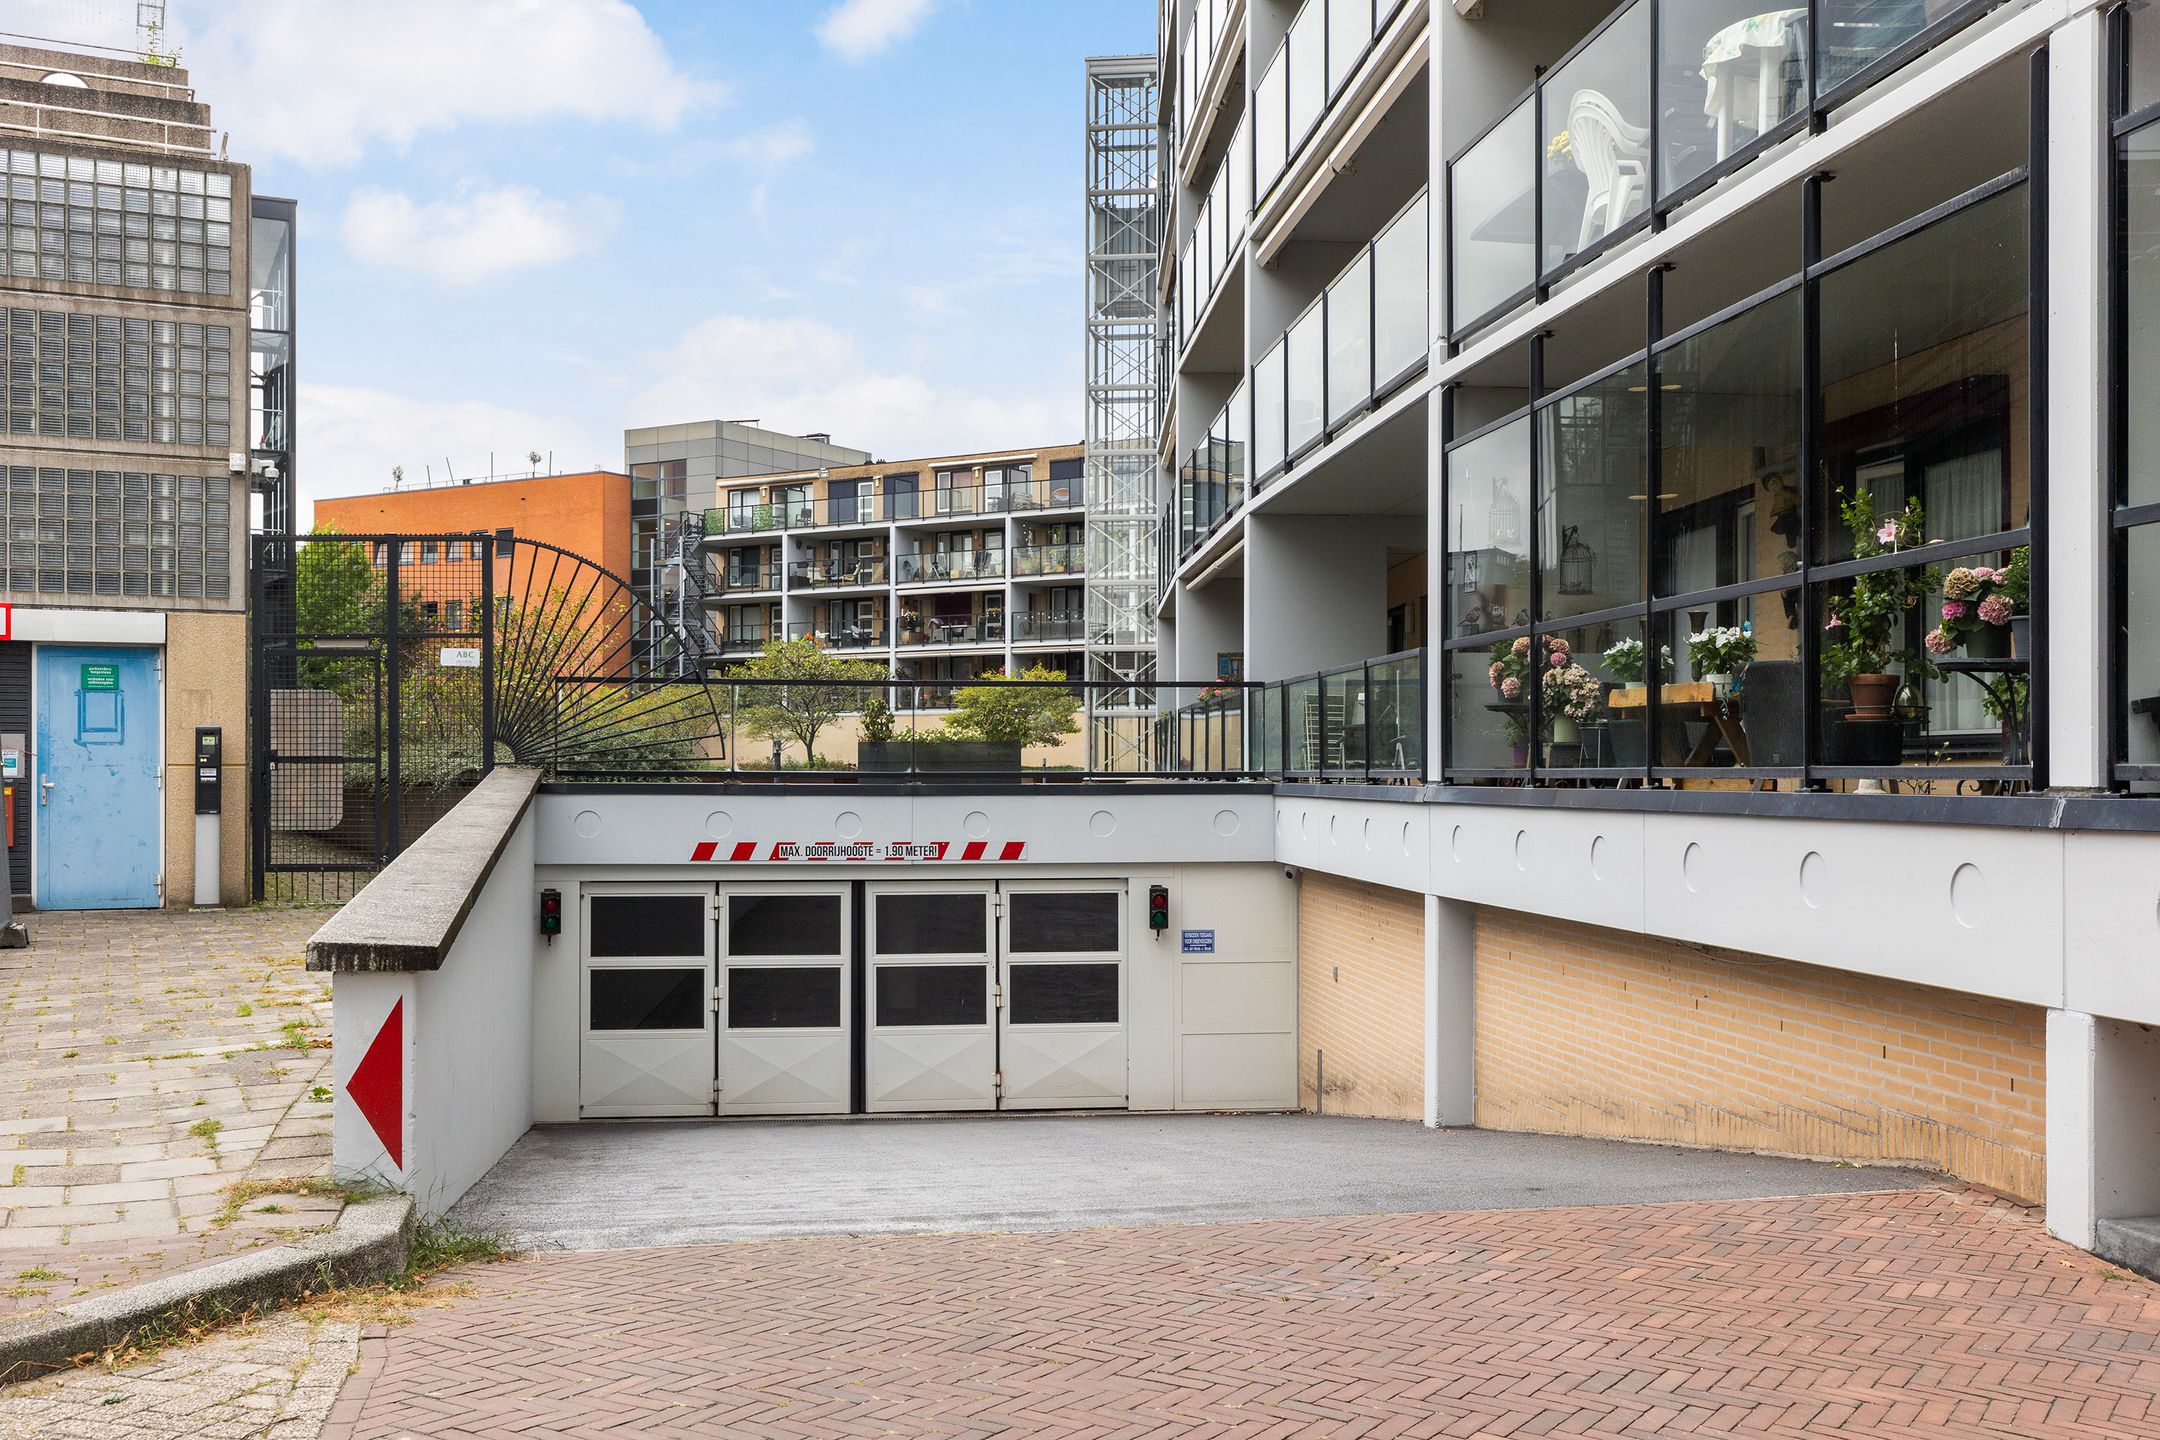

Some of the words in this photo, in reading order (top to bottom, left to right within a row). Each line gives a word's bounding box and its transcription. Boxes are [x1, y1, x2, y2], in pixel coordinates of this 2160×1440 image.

[456, 650, 475, 658] ABC
[780, 845, 803, 857] MAX.
[805, 845, 874, 857] DOORRIJHOOGTE
[885, 845, 904, 857] 1.90
[905, 845, 937, 857] METER!
